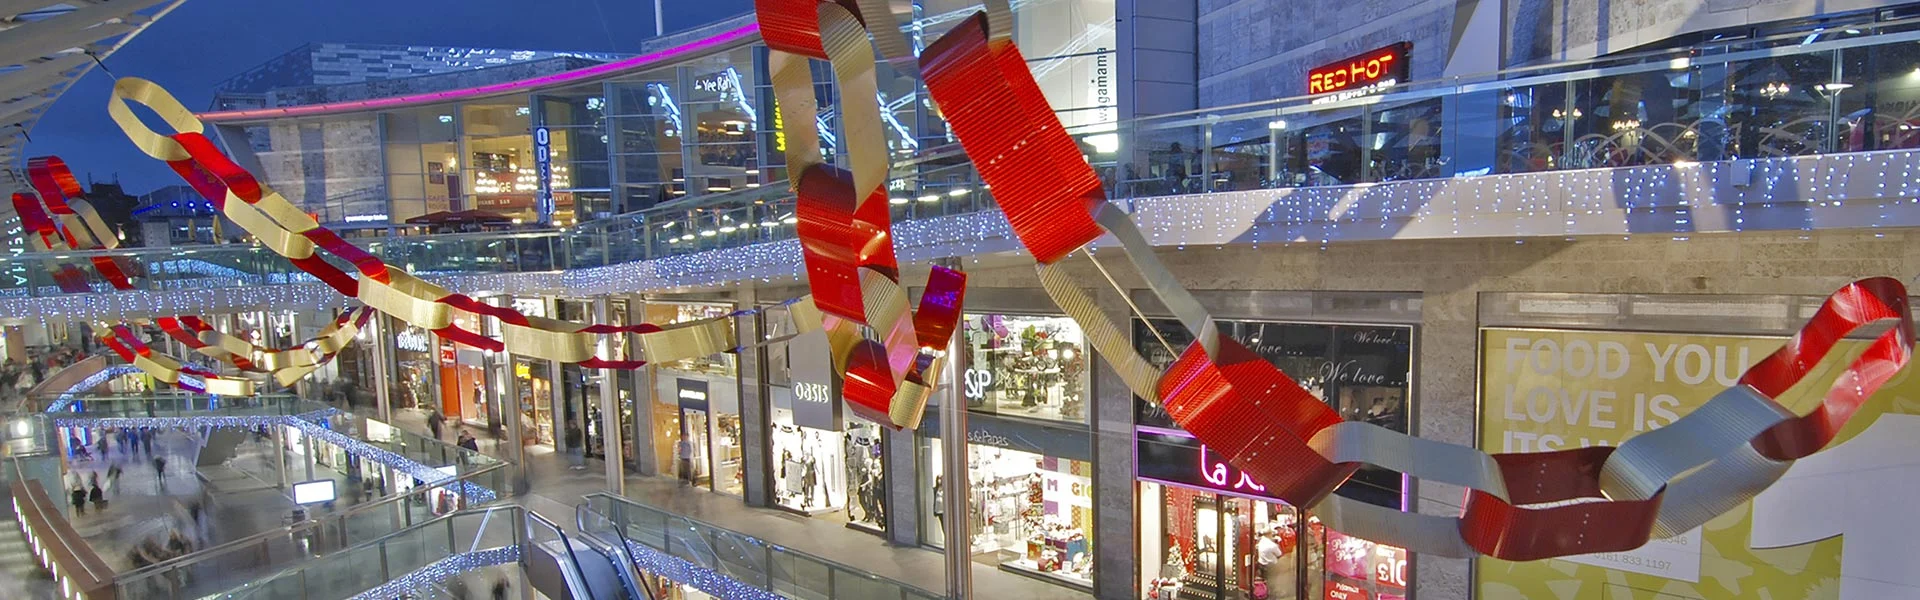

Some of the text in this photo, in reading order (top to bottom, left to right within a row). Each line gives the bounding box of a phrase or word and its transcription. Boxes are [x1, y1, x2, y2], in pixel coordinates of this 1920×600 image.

[1097, 47, 1110, 122] wagamama
[1310, 54, 1393, 94] RED HOT
[1505, 337, 1749, 387] FOOD YOU
[1503, 383, 1682, 432] LOVE IS
[1622, 555, 1642, 566] 833
[1645, 559, 1672, 572] 1197
